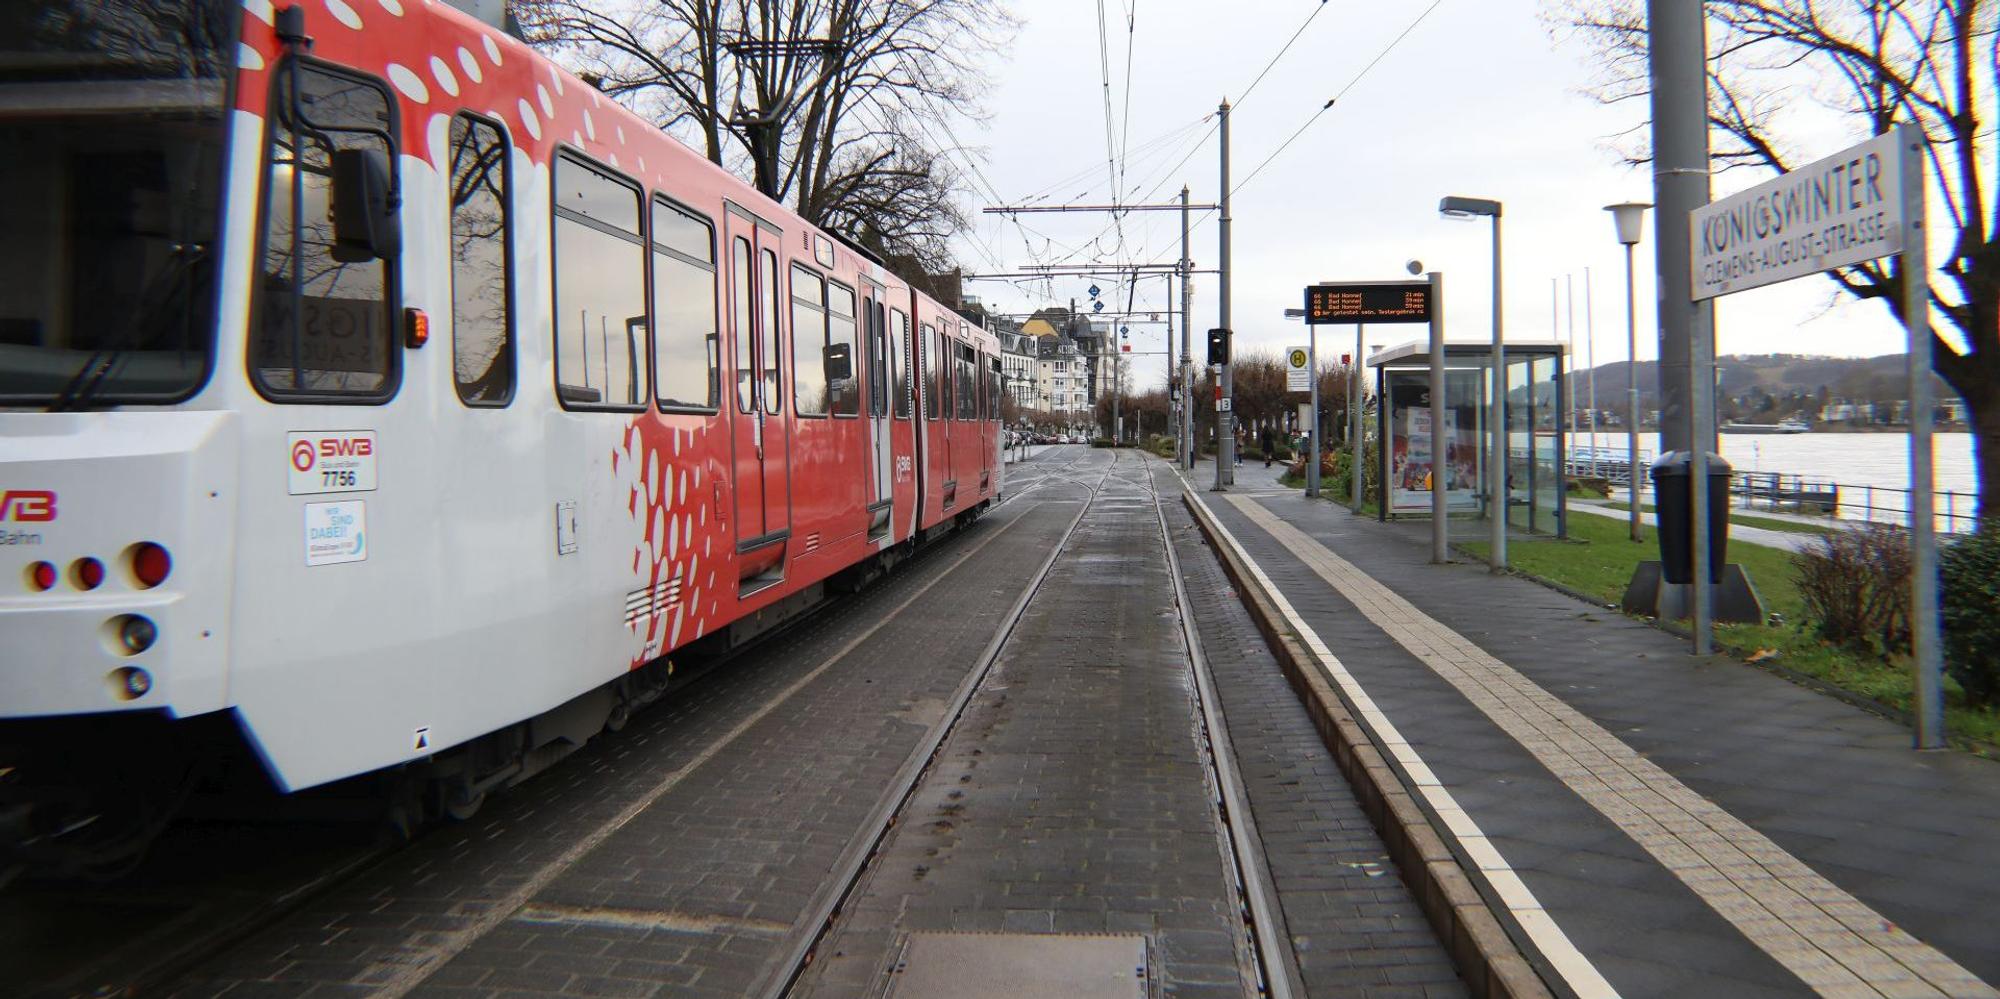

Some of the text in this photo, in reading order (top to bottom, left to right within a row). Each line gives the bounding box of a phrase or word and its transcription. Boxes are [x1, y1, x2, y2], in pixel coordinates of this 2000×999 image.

[1703, 152, 1885, 257] KÖNIGSWINTER
[1703, 212, 1886, 285] CLEMENS-AUGUST-STRASSE
[1293, 354, 1302, 364] H
[1224, 400, 1229, 408] 3
[320, 438, 372, 457] SWB
[322, 471, 356, 487] 7756
